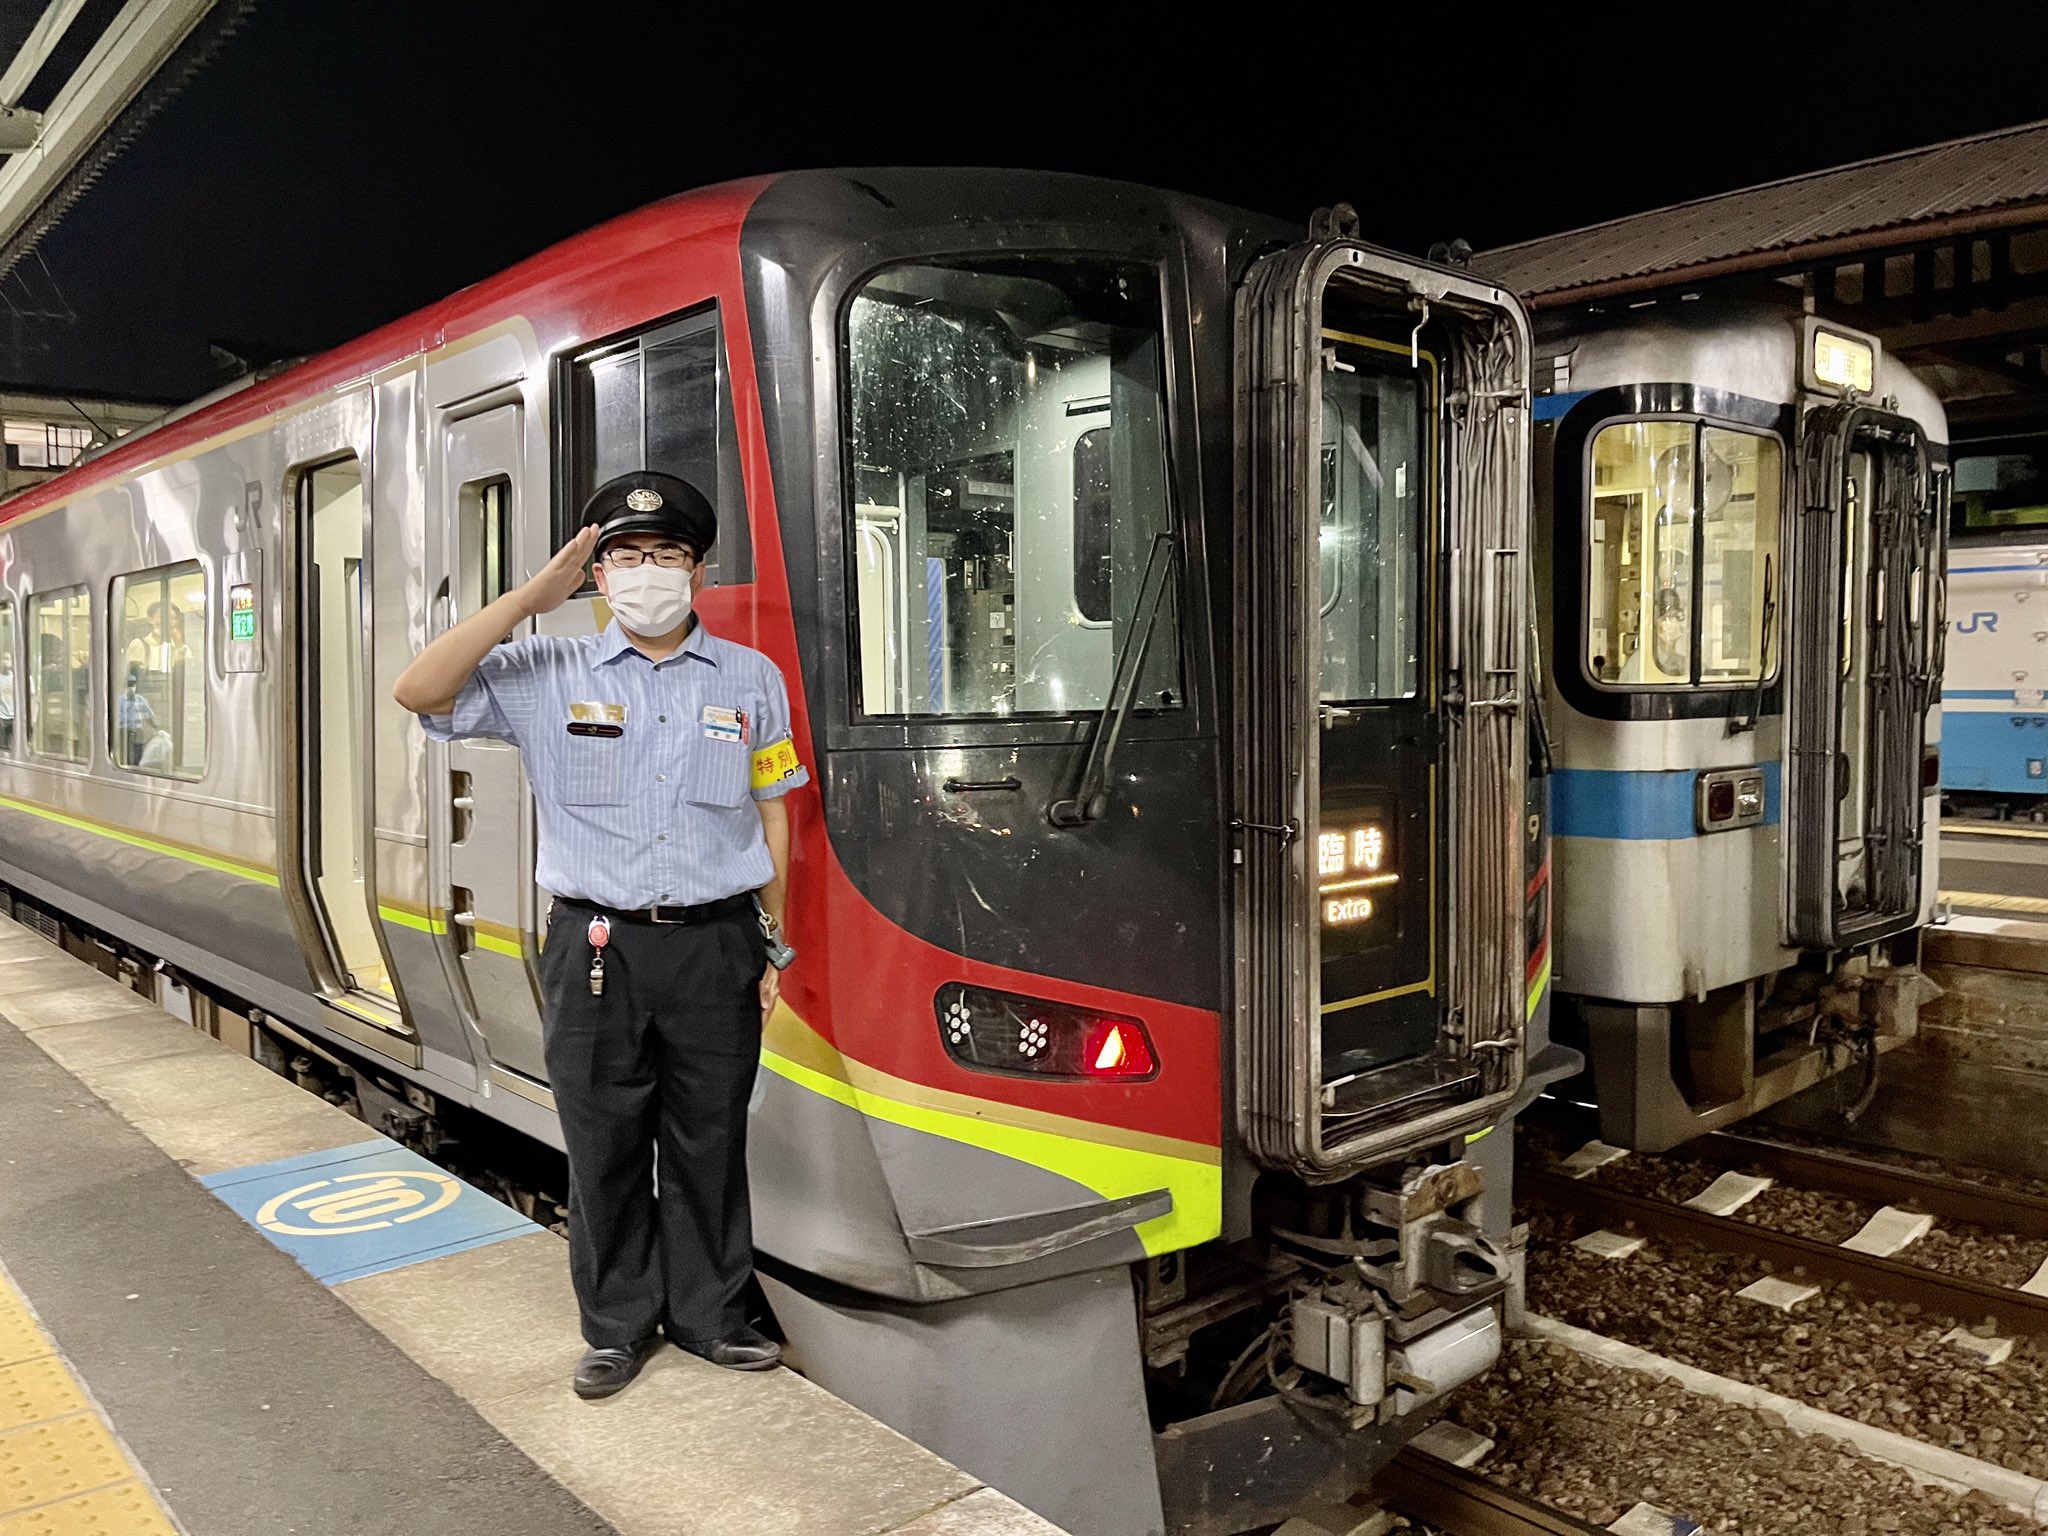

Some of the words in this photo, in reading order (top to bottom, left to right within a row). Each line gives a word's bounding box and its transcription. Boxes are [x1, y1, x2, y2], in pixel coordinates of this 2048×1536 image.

[234, 480, 263, 532] JR
[1956, 611, 1998, 634] JR
[756, 748, 793, 775] 特別
[1528, 814, 1540, 842] 9
[1318, 827, 1382, 874] 臨時
[1327, 897, 1372, 923] Extra
[291, 1177, 426, 1224] 10
